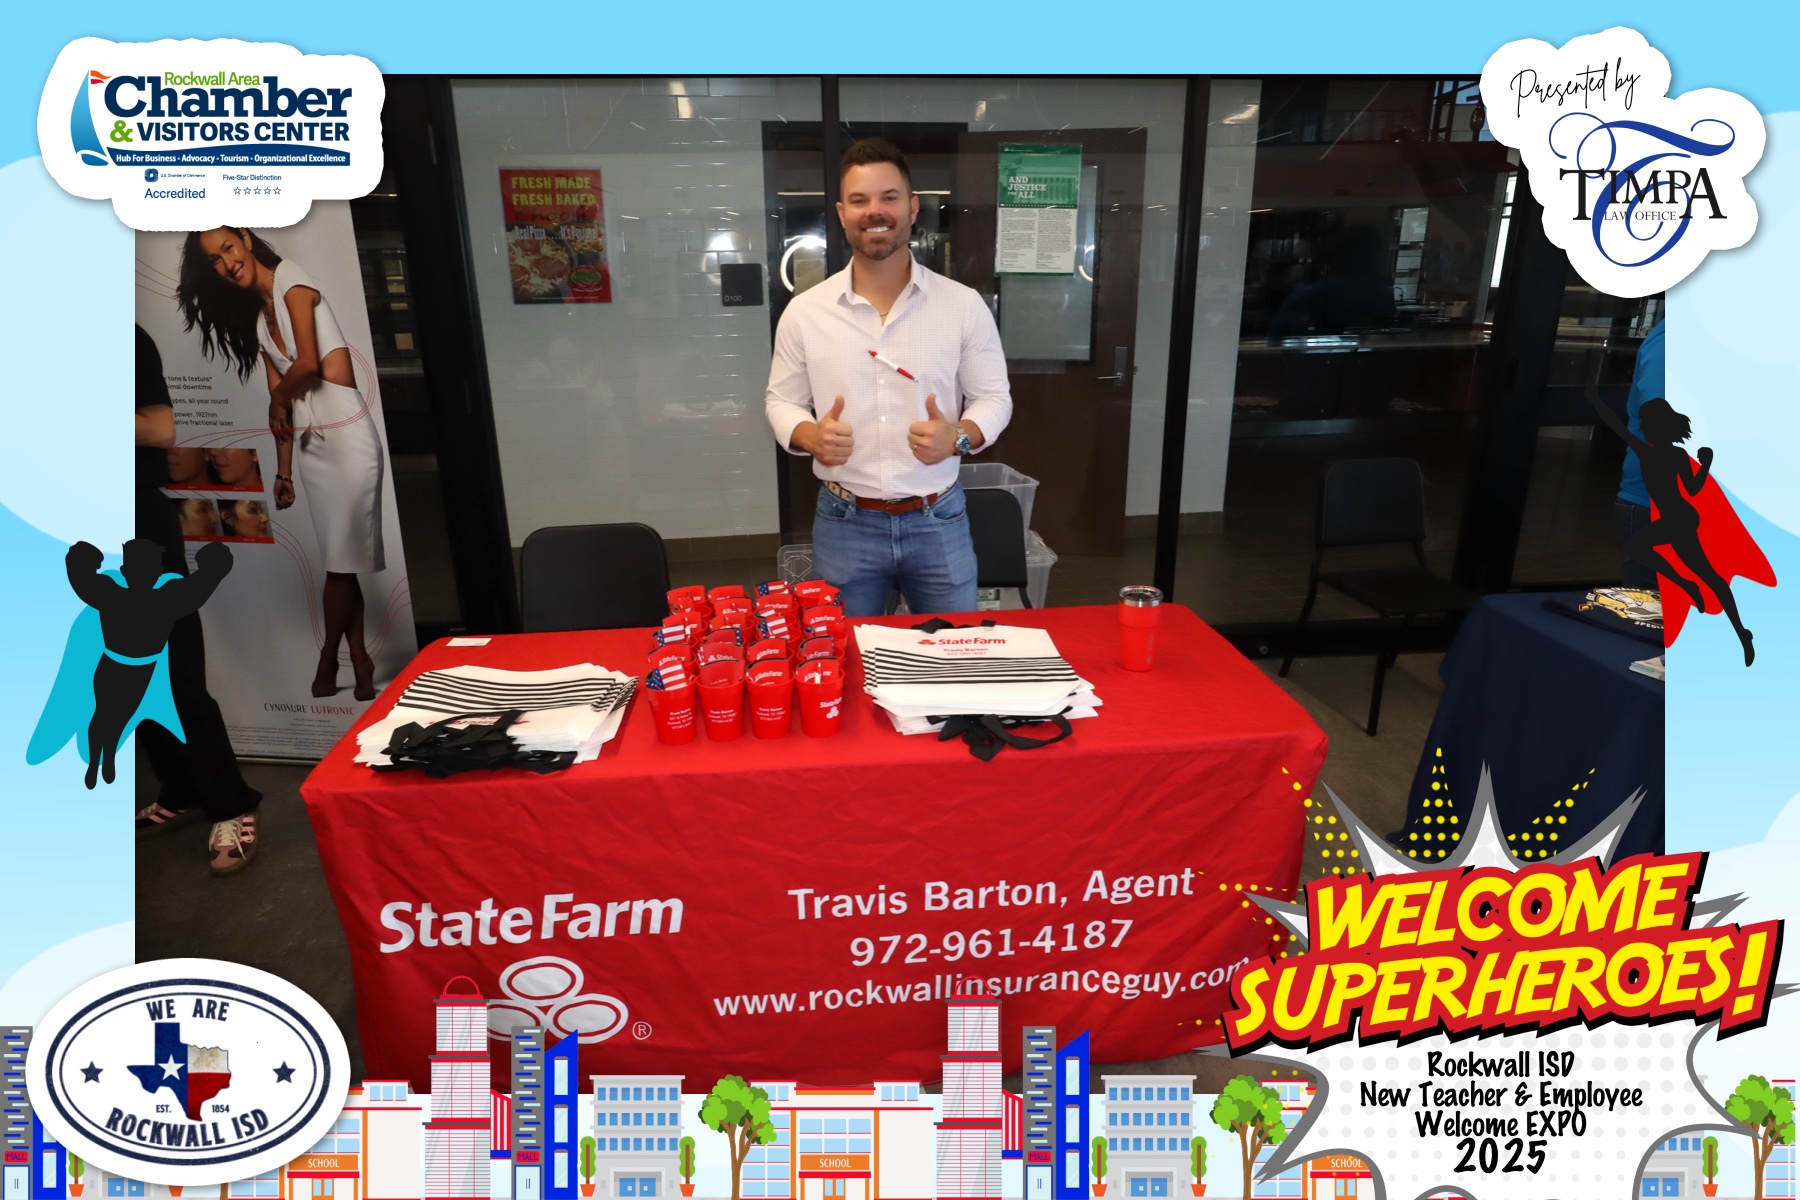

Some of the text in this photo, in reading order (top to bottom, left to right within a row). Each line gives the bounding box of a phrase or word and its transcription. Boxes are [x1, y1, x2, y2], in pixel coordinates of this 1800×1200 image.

[511, 176, 592, 189] FRESH MADE
[1008, 176, 1029, 184] AND
[1007, 183, 1047, 191] JUSTICE
[512, 193, 597, 206] FRESH BAKED
[1018, 191, 1036, 199] ALL
[973, 637, 1006, 645] Farm
[263, 702, 355, 716] CYNOSURE LUTRONIC
[787, 867, 1195, 920] Travis Barton, Agent
[380, 892, 684, 954] State Farm
[850, 918, 1134, 967] 972-961-4187
